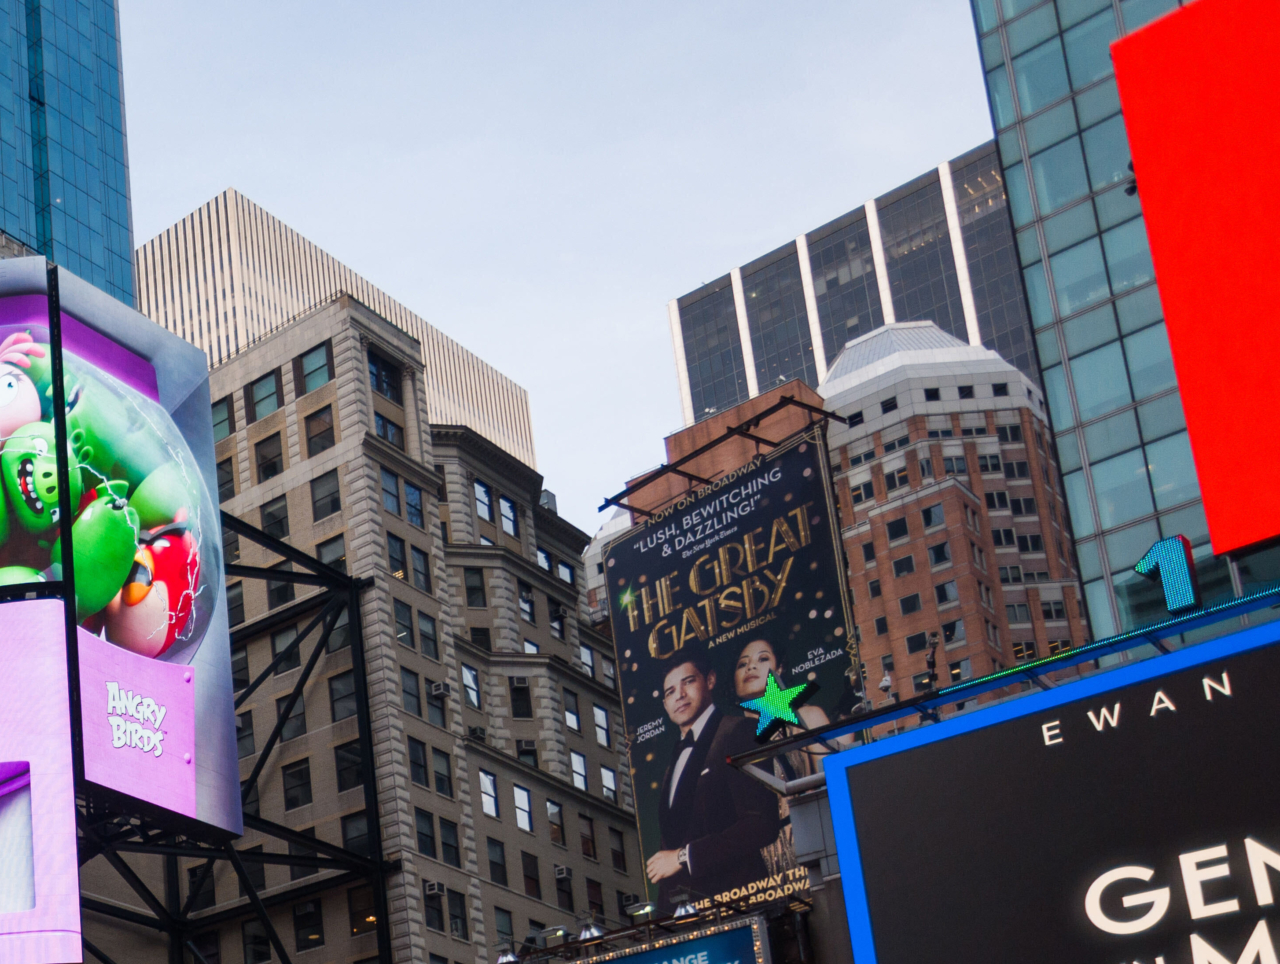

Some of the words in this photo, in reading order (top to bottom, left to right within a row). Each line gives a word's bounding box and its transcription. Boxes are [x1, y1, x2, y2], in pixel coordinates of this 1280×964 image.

[648, 507, 675, 527] NOW
[677, 495, 695, 510] ON
[697, 457, 762, 498] BROADWAY
[682, 467, 782, 529] BEWITCHING
[662, 544, 672, 557] &
[719, 526, 738, 539] Times
[621, 571, 682, 633] THE
[689, 501, 814, 595] GREAT
[648, 557, 794, 659] GATSBY
[708, 640, 714, 649] A
[716, 632, 735, 648] NEW
[737, 612, 777, 637] MUSICAL
[792, 648, 843, 675] NOBLEZADA
[807, 647, 823, 660] EVA
[105, 681, 167, 730] ANGRY
[1041, 670, 1232, 747] EWAN
[107, 716, 164, 758] BIRDS
[636, 717, 663, 735] JEREMY
[637, 726, 665, 743] JORDAN
[714, 873, 782, 905] BROADWAY
